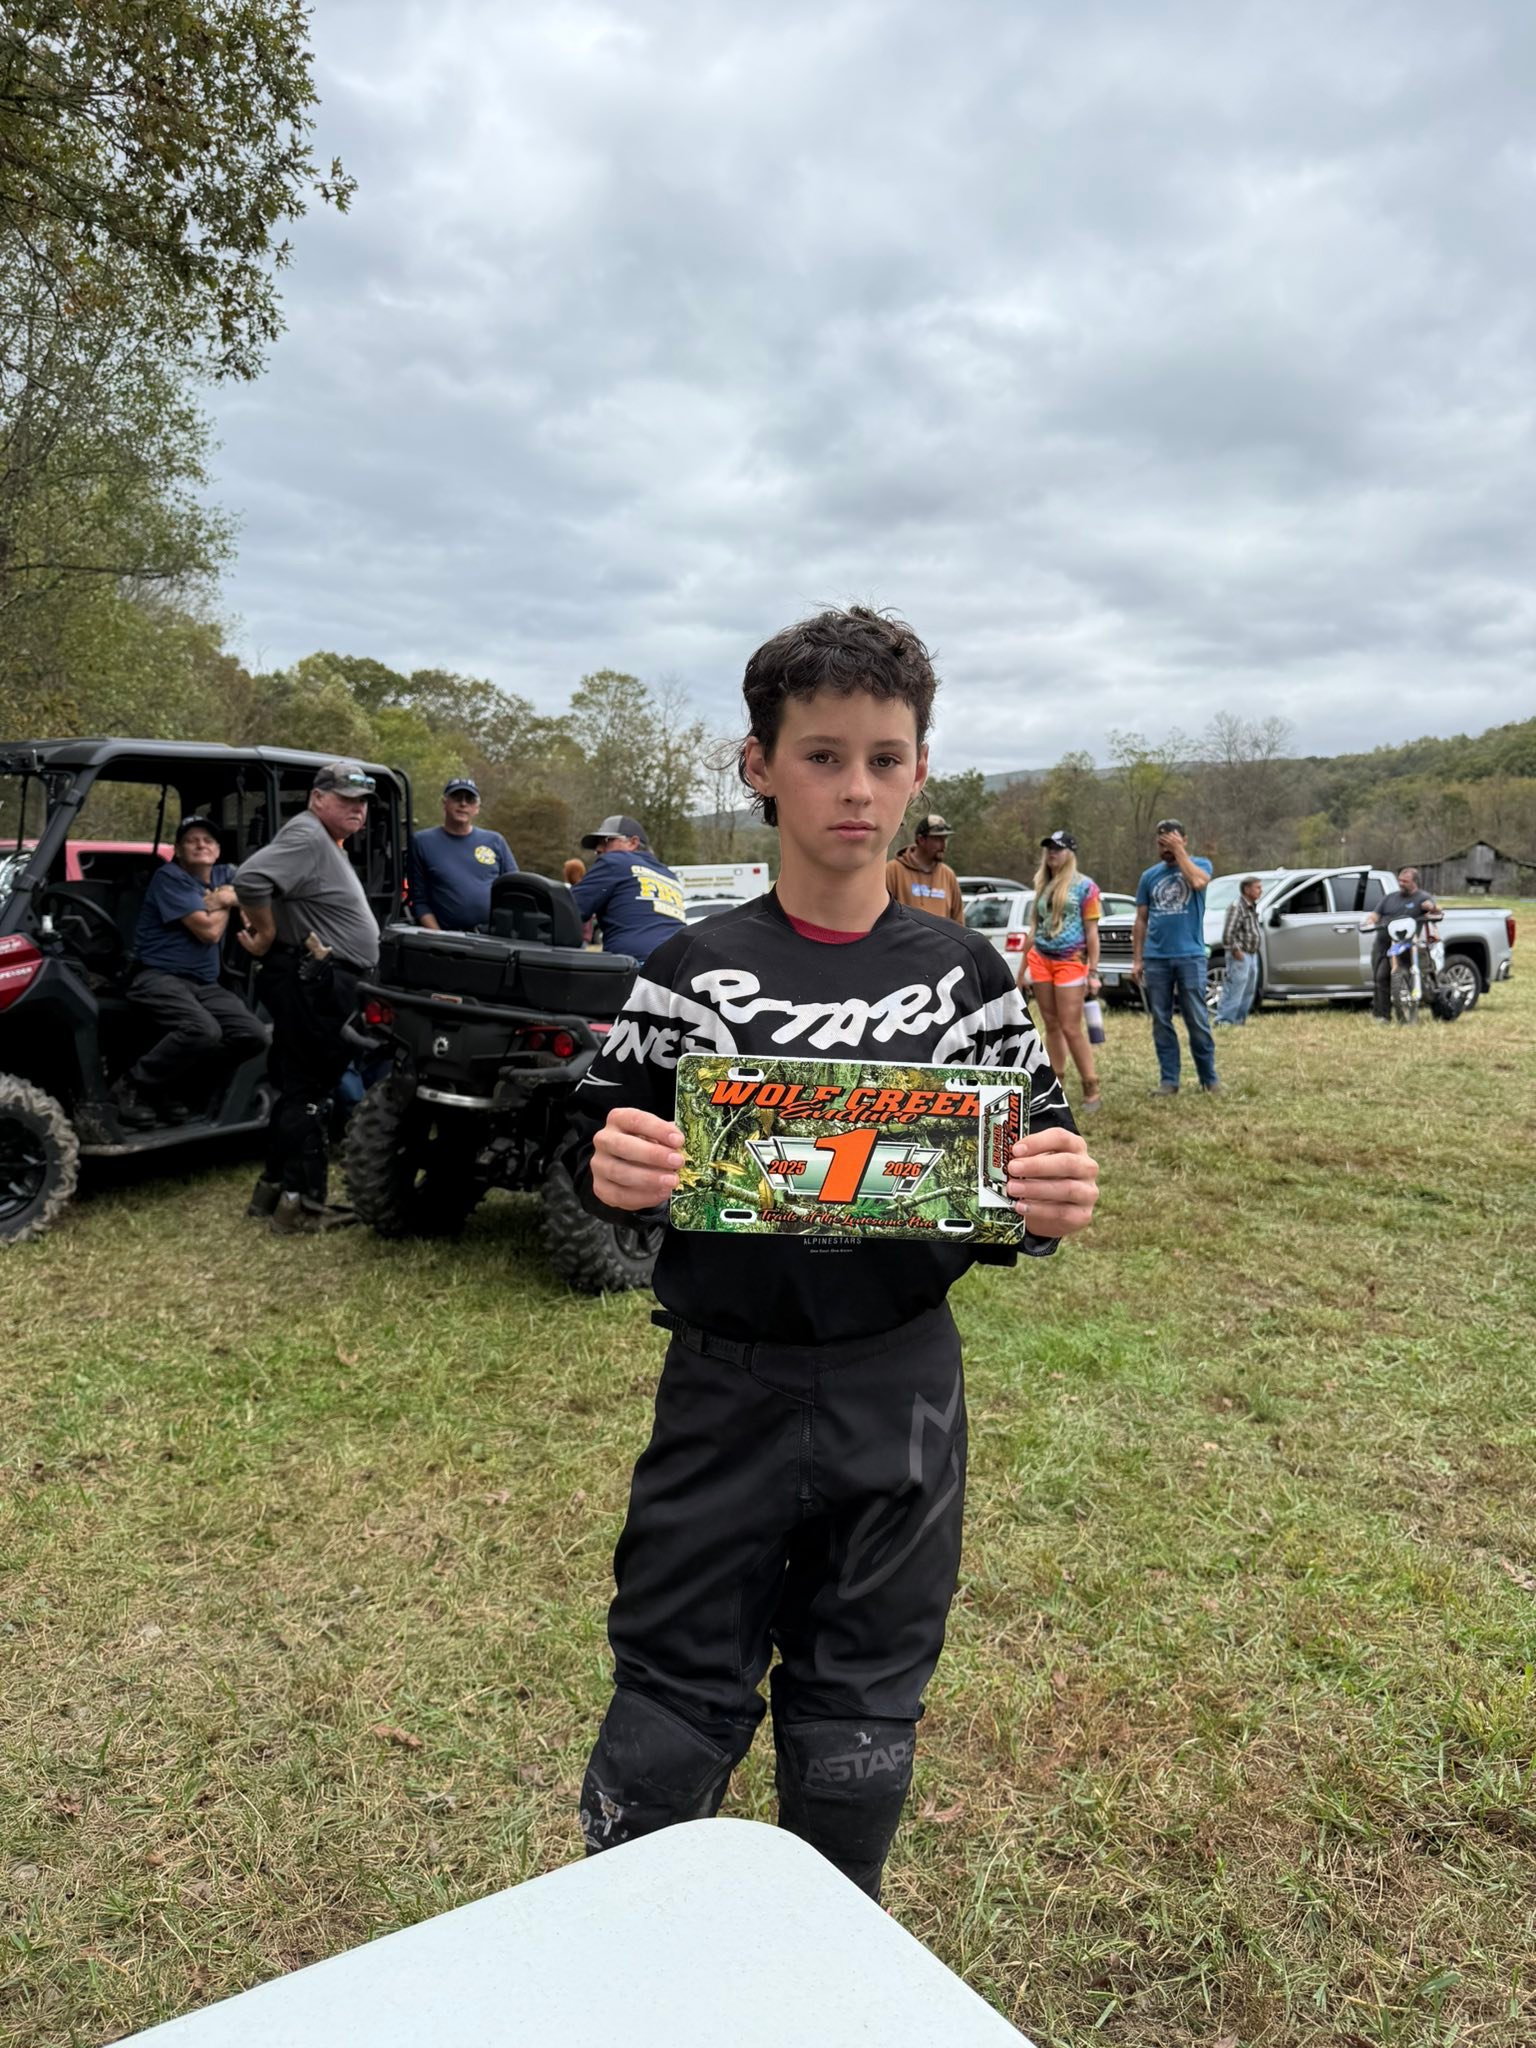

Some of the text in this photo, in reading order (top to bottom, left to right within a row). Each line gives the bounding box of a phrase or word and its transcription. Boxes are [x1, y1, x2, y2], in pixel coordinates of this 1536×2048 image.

[710, 1080, 844, 1109] WOLF
[779, 1098, 920, 1124] Enduro
[768, 1159, 808, 1176] 2025
[813, 1128, 879, 1204] 1
[882, 1160, 923, 1178] 2026
[760, 1209, 936, 1229] Trails of the Lonesome Pine
[803, 1237, 862, 1245] ALPINESTARS
